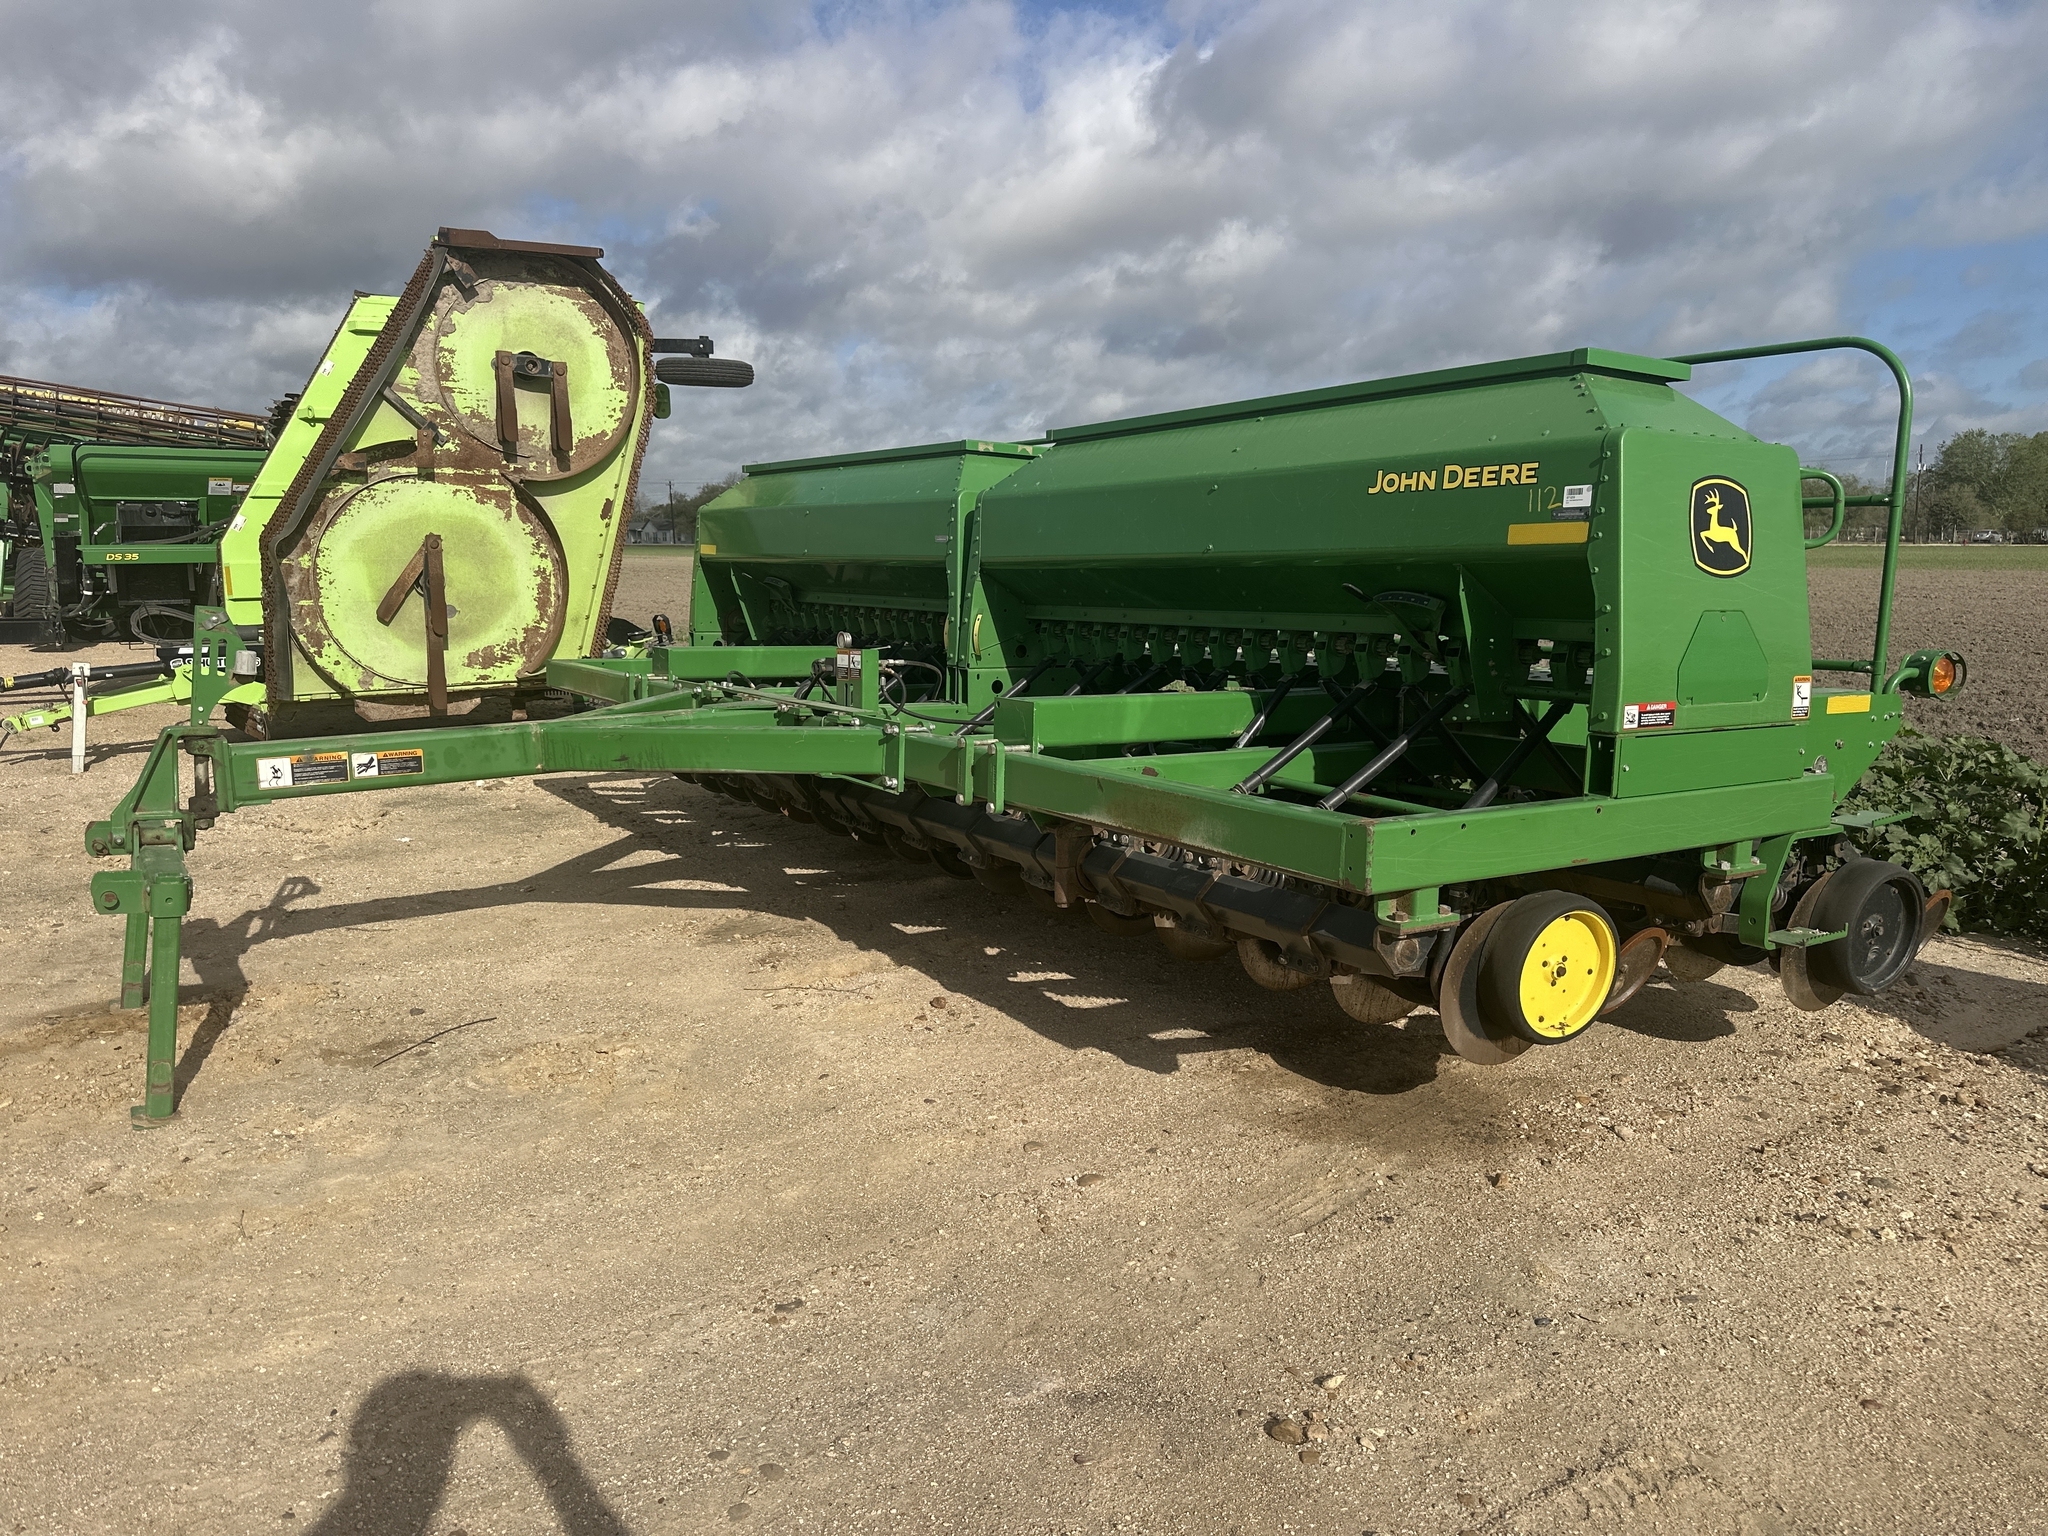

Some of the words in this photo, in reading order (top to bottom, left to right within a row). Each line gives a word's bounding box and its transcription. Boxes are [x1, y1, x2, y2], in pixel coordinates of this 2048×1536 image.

[1367, 469, 1437, 494] JOHN
[1441, 461, 1540, 490] DEERE
[1528, 486, 1562, 512] 112
[106, 553, 122, 561] DS
[124, 553, 139, 561] 35
[308, 754, 342, 762] ARNING
[387, 750, 418, 758] WARNING
